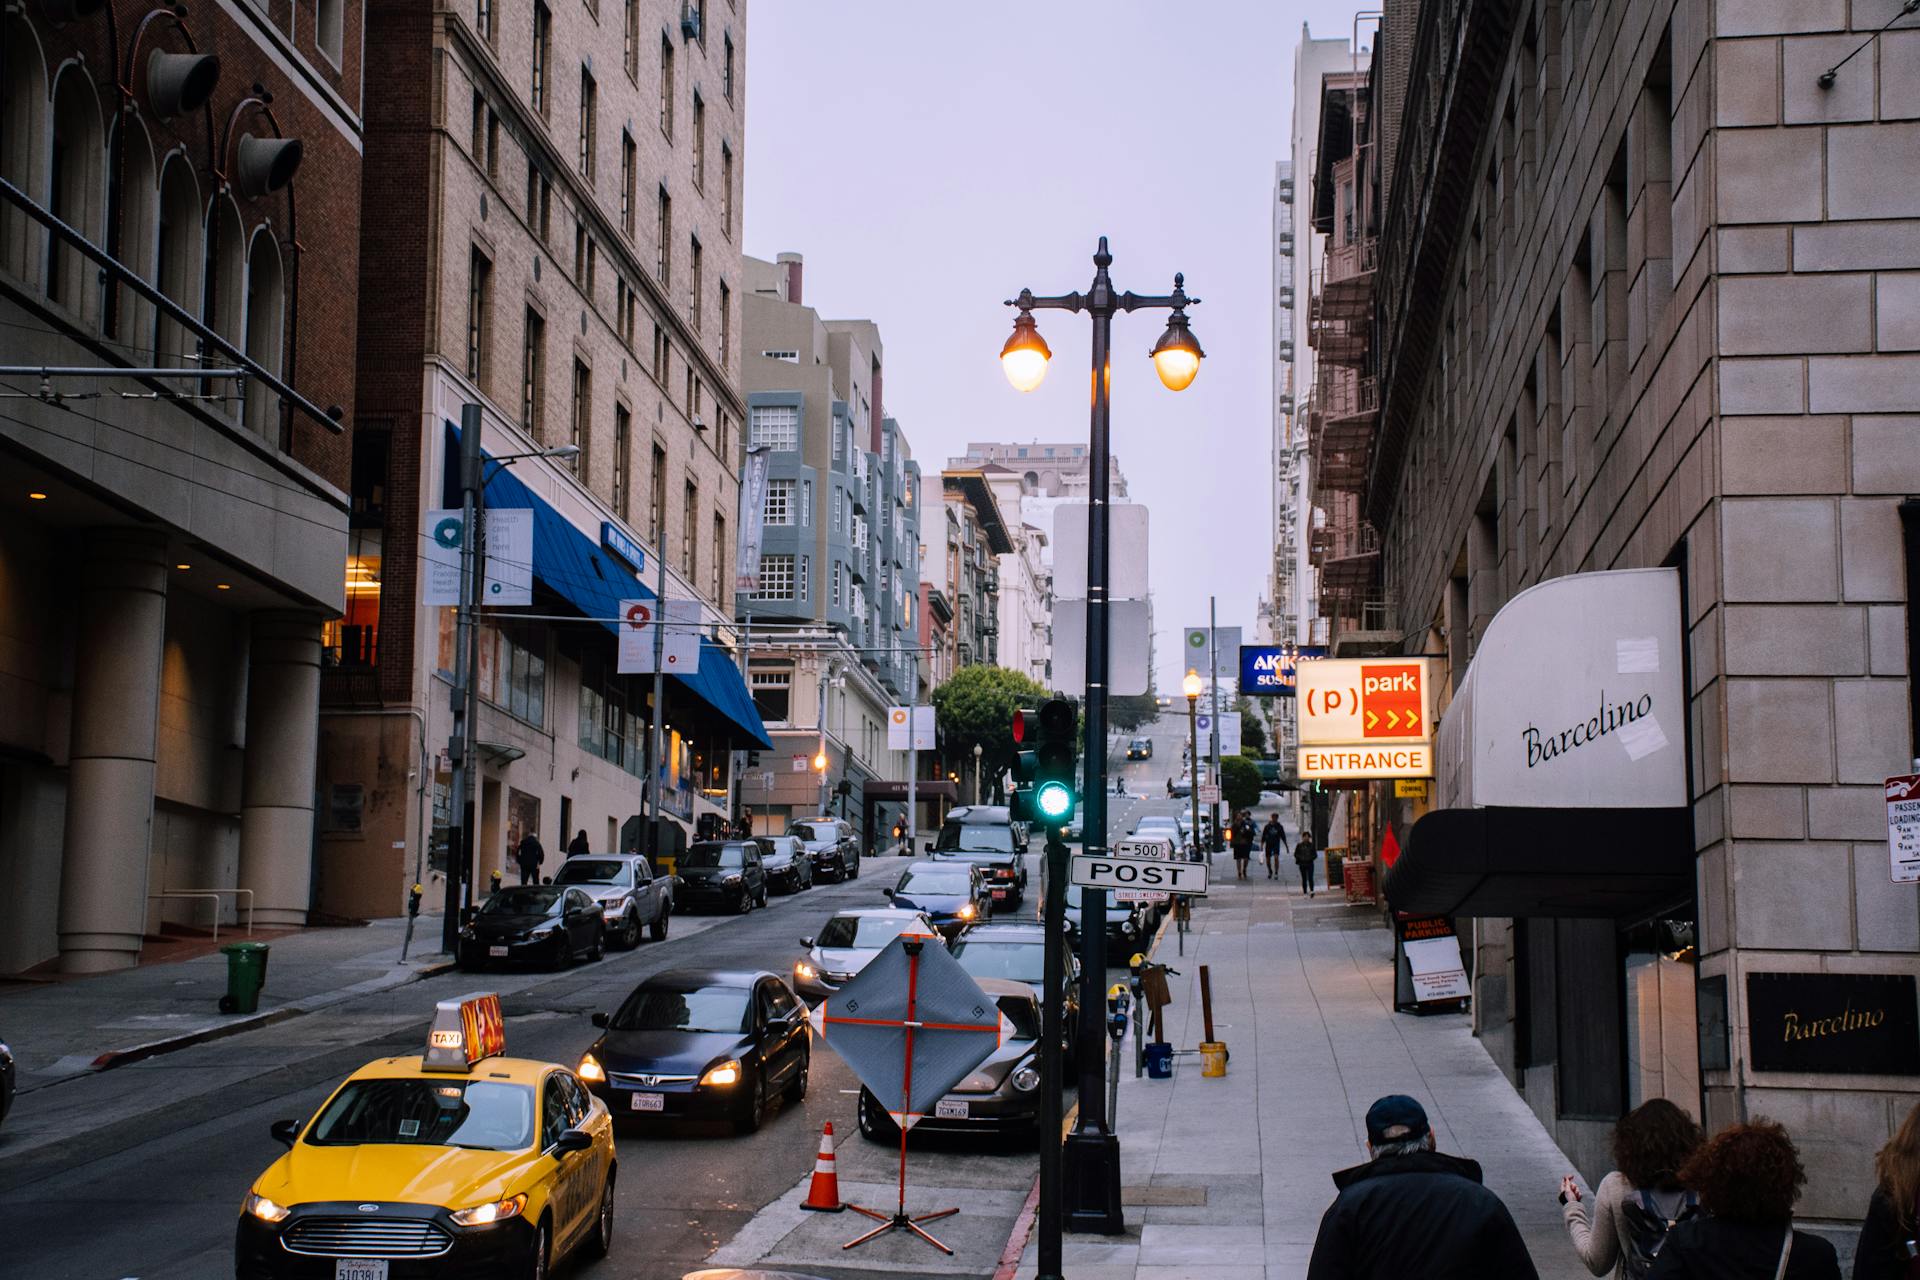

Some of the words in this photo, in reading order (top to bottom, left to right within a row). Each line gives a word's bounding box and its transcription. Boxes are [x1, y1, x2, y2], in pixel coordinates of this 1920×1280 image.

[1364, 672, 1417, 696] park
[1522, 689, 1652, 768] Barcelino
[1306, 752, 1423, 770] ENTRANCE
[1889, 814, 1920, 825] LOADING
[1134, 844, 1158, 857] 500
[1090, 862, 1185, 885] POST
[1407, 919, 1446, 930] PUBLIC
[1404, 926, 1451, 939] PARKING
[1784, 999, 1884, 1042] Barcelino
[434, 1034, 460, 1043] TAXI
